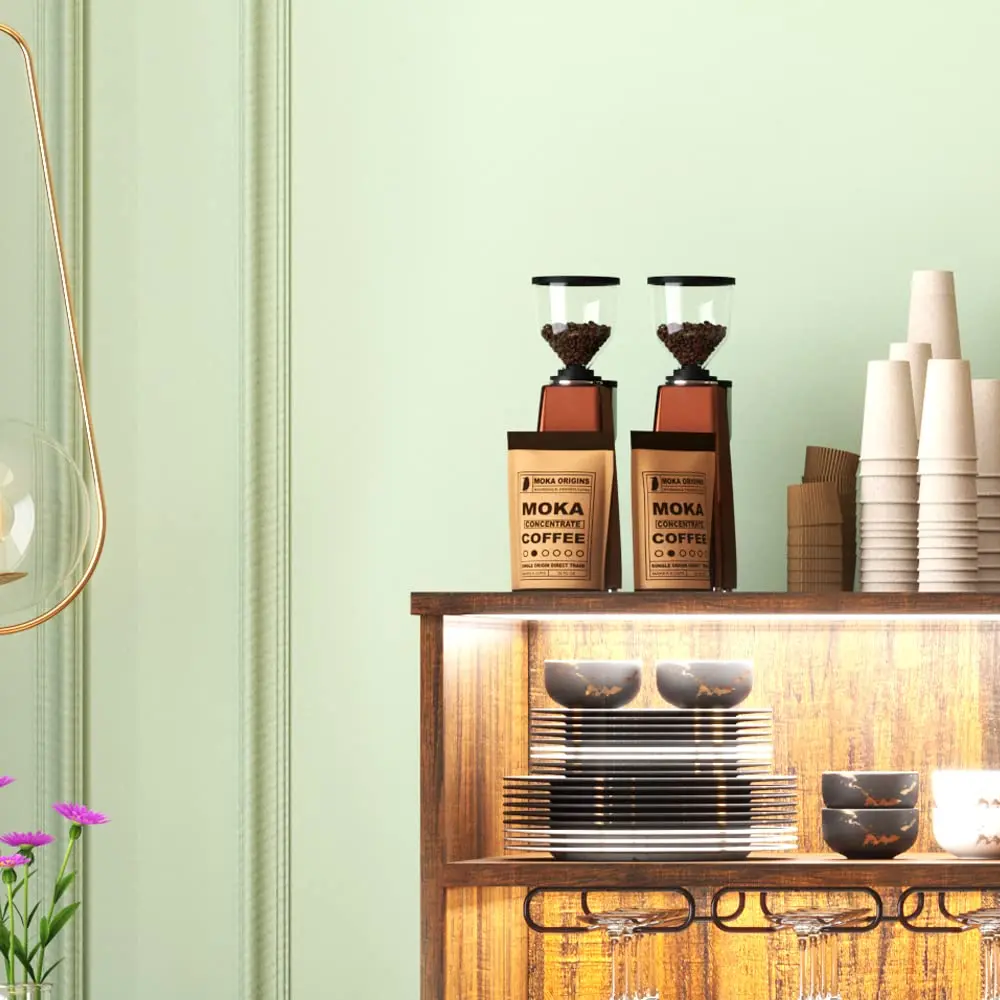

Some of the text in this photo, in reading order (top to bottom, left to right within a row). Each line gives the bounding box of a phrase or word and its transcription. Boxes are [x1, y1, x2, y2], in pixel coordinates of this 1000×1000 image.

[533, 477, 590, 485] MOKA ORIGINS
[522, 502, 584, 516] MOKA
[652, 502, 704, 516] MOKA
[525, 520, 581, 528] CONCENTRATE
[522, 533, 585, 544] COFFEE
[652, 533, 707, 545] COFFEE
